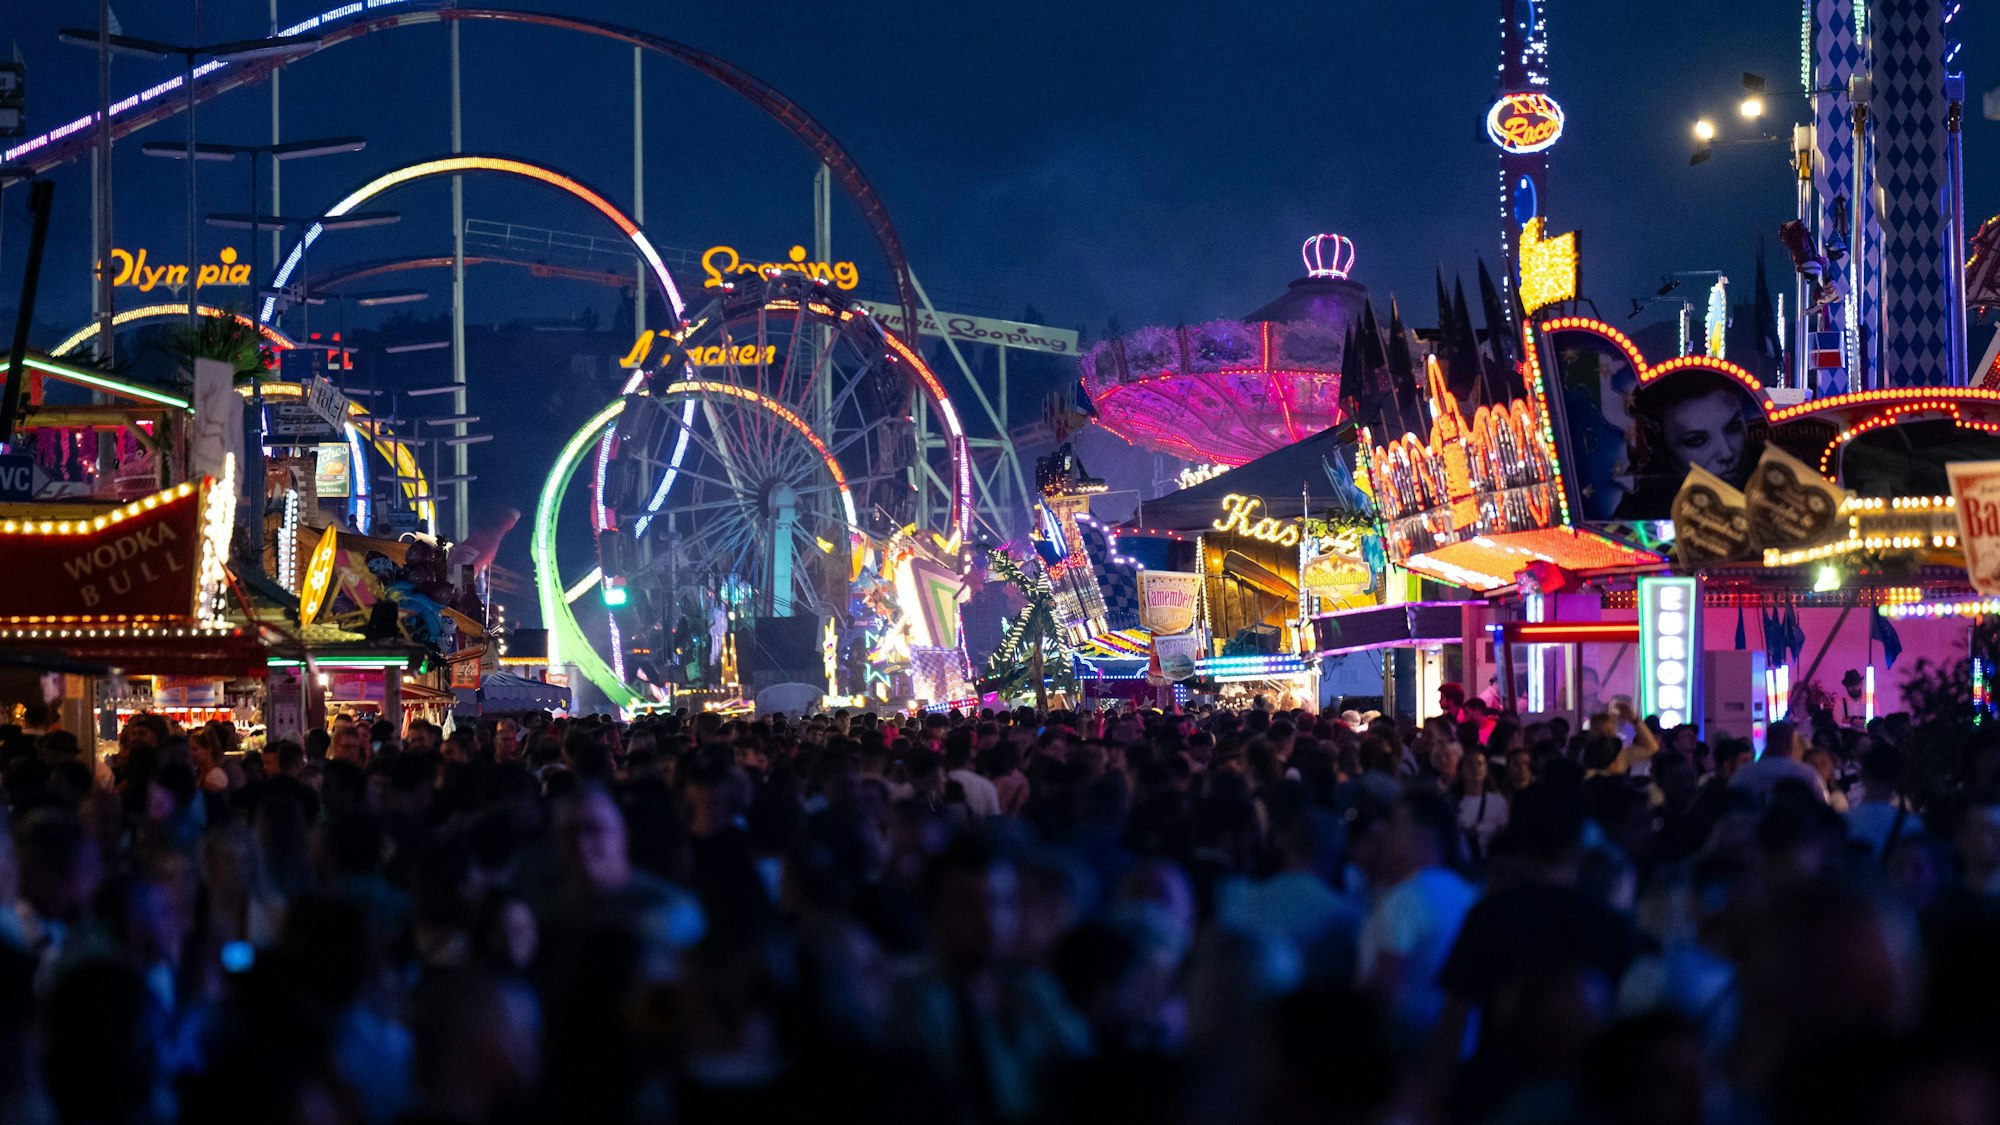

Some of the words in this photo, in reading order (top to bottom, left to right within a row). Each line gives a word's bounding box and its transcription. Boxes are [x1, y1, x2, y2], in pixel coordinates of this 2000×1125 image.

[1504, 117, 1560, 147] Racer
[97, 247, 251, 292] Olympia
[948, 317, 1067, 353] Looping
[63, 521, 178, 581] WODKA
[80, 554, 185, 608] BULL
